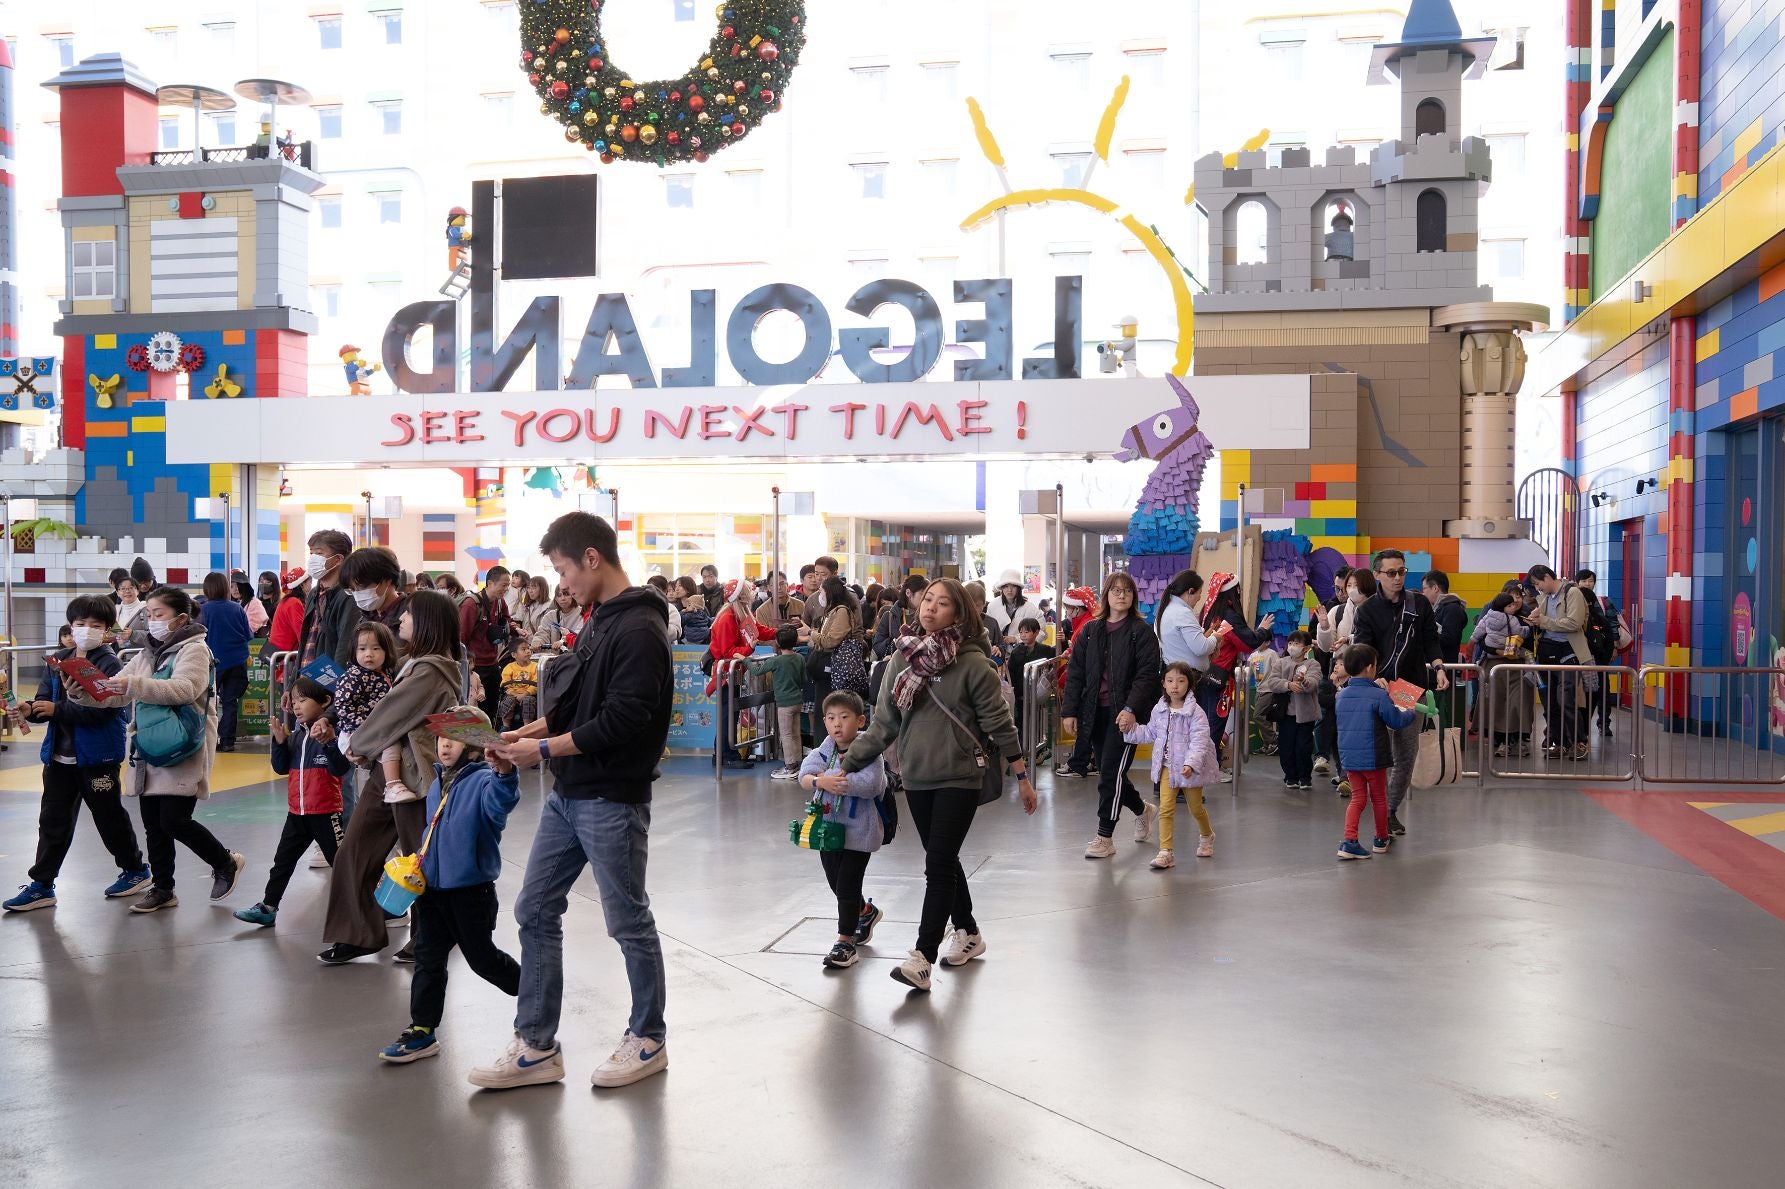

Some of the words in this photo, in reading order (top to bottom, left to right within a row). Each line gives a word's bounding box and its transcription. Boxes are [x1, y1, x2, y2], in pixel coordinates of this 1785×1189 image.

[381, 410, 484, 447] SEE
[500, 407, 620, 447] YOU
[643, 404, 808, 442] NEXT
[829, 400, 991, 442] TIME
